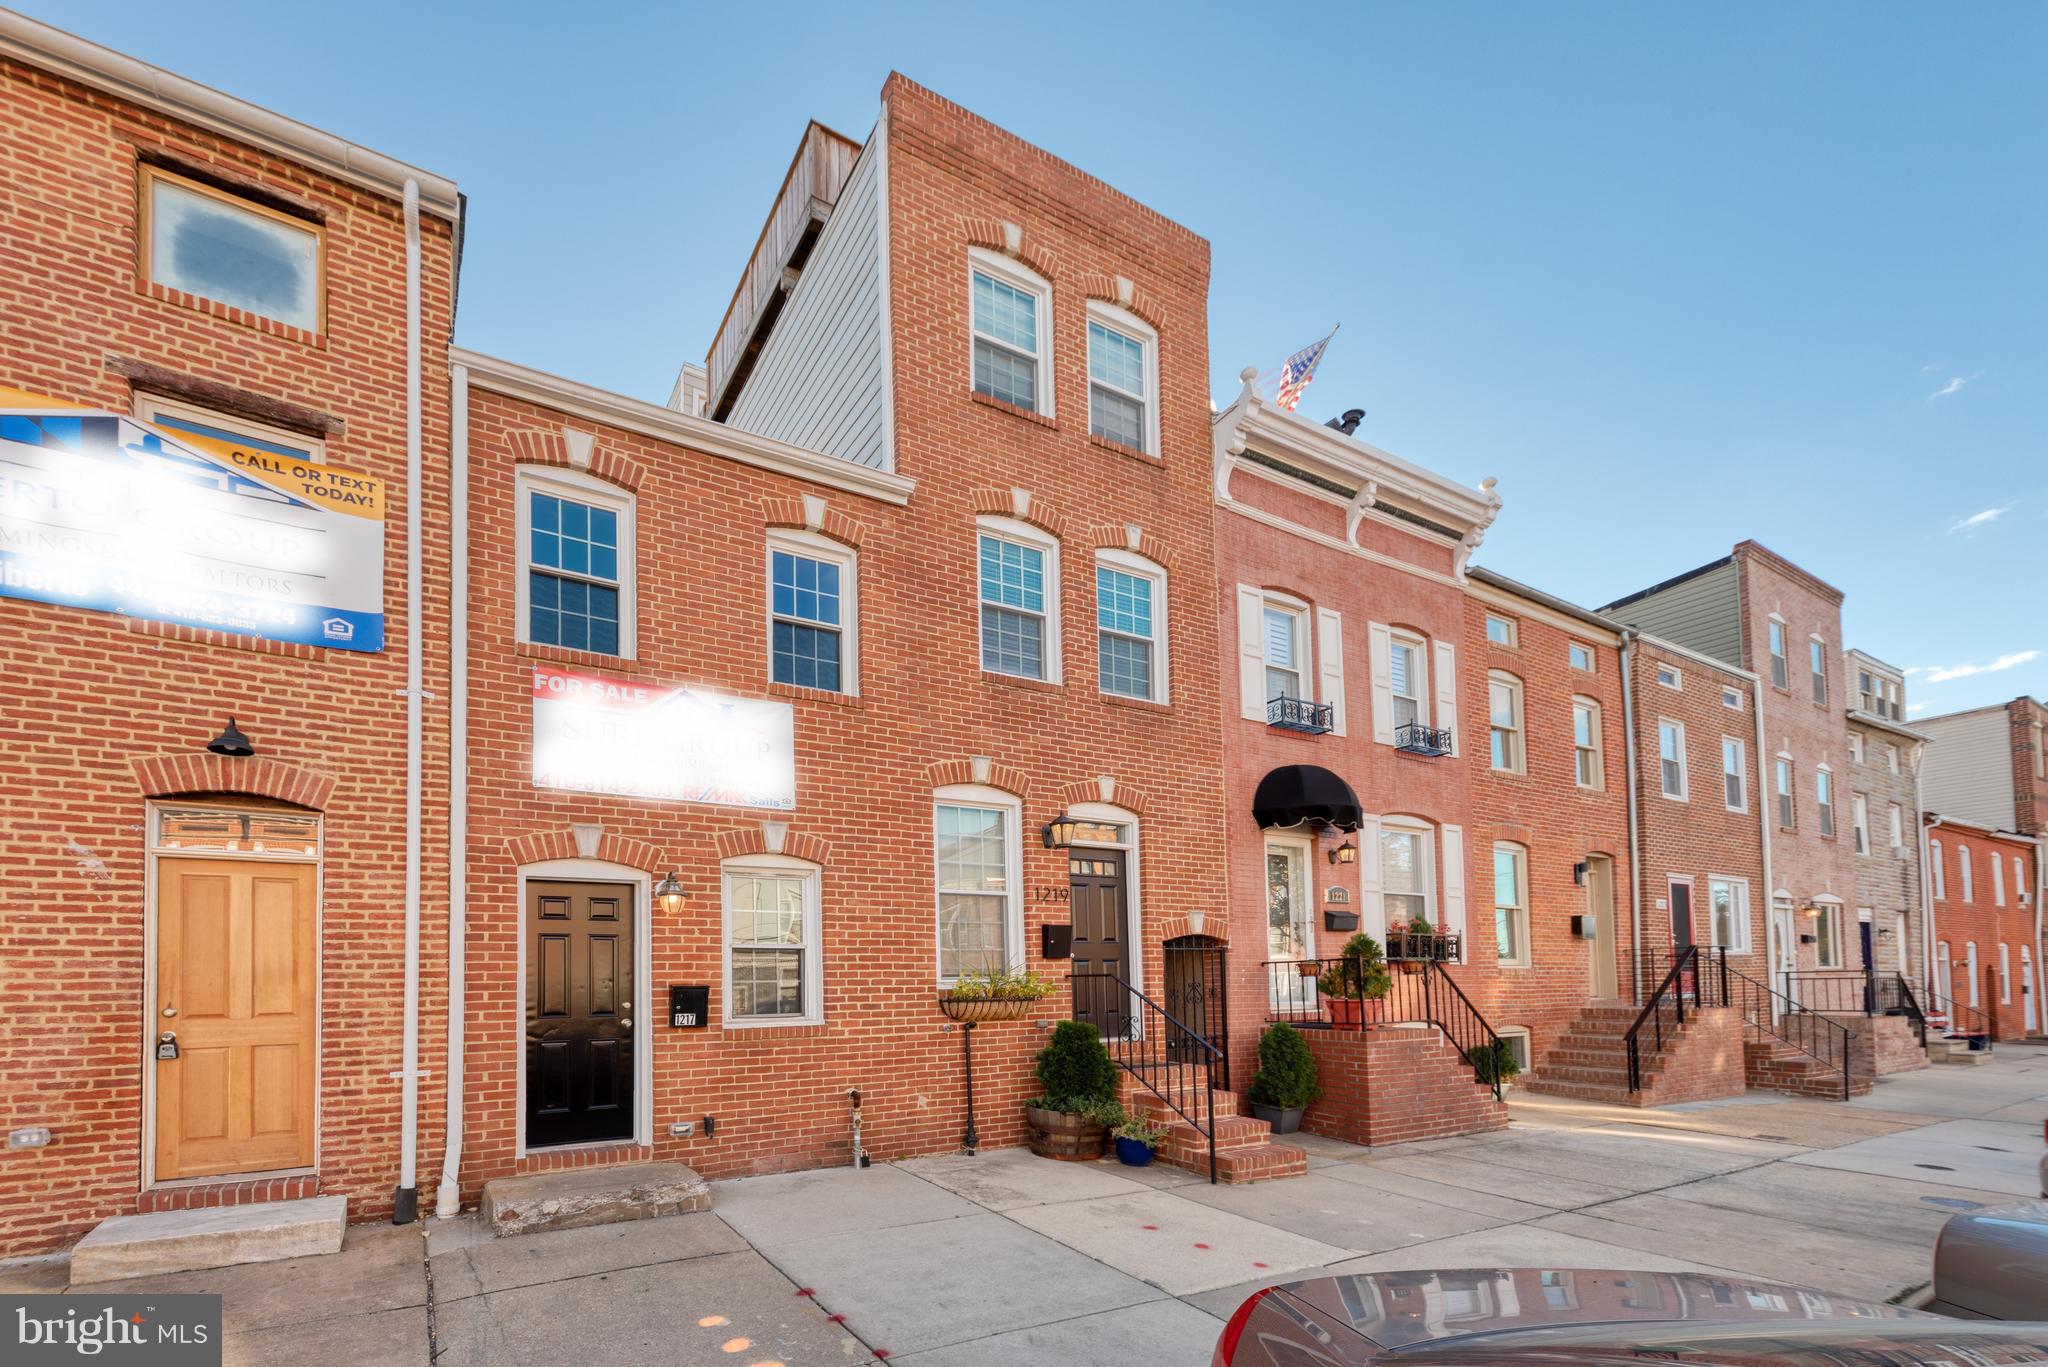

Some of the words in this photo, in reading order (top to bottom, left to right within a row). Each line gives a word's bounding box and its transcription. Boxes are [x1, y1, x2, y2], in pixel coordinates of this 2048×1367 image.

[231, 450, 286, 475] CALL
[292, 466, 321, 482] OR
[326, 471, 377, 494] TEXT
[301, 482, 375, 508] TODAY!
[534, 673, 583, 695] FOR
[590, 682, 648, 704] SALE
[750, 795, 781, 808] Sails
[1034, 887, 1069, 902] 1219
[1332, 891, 1346, 901] 1221
[676, 1014, 695, 1026] 1217
